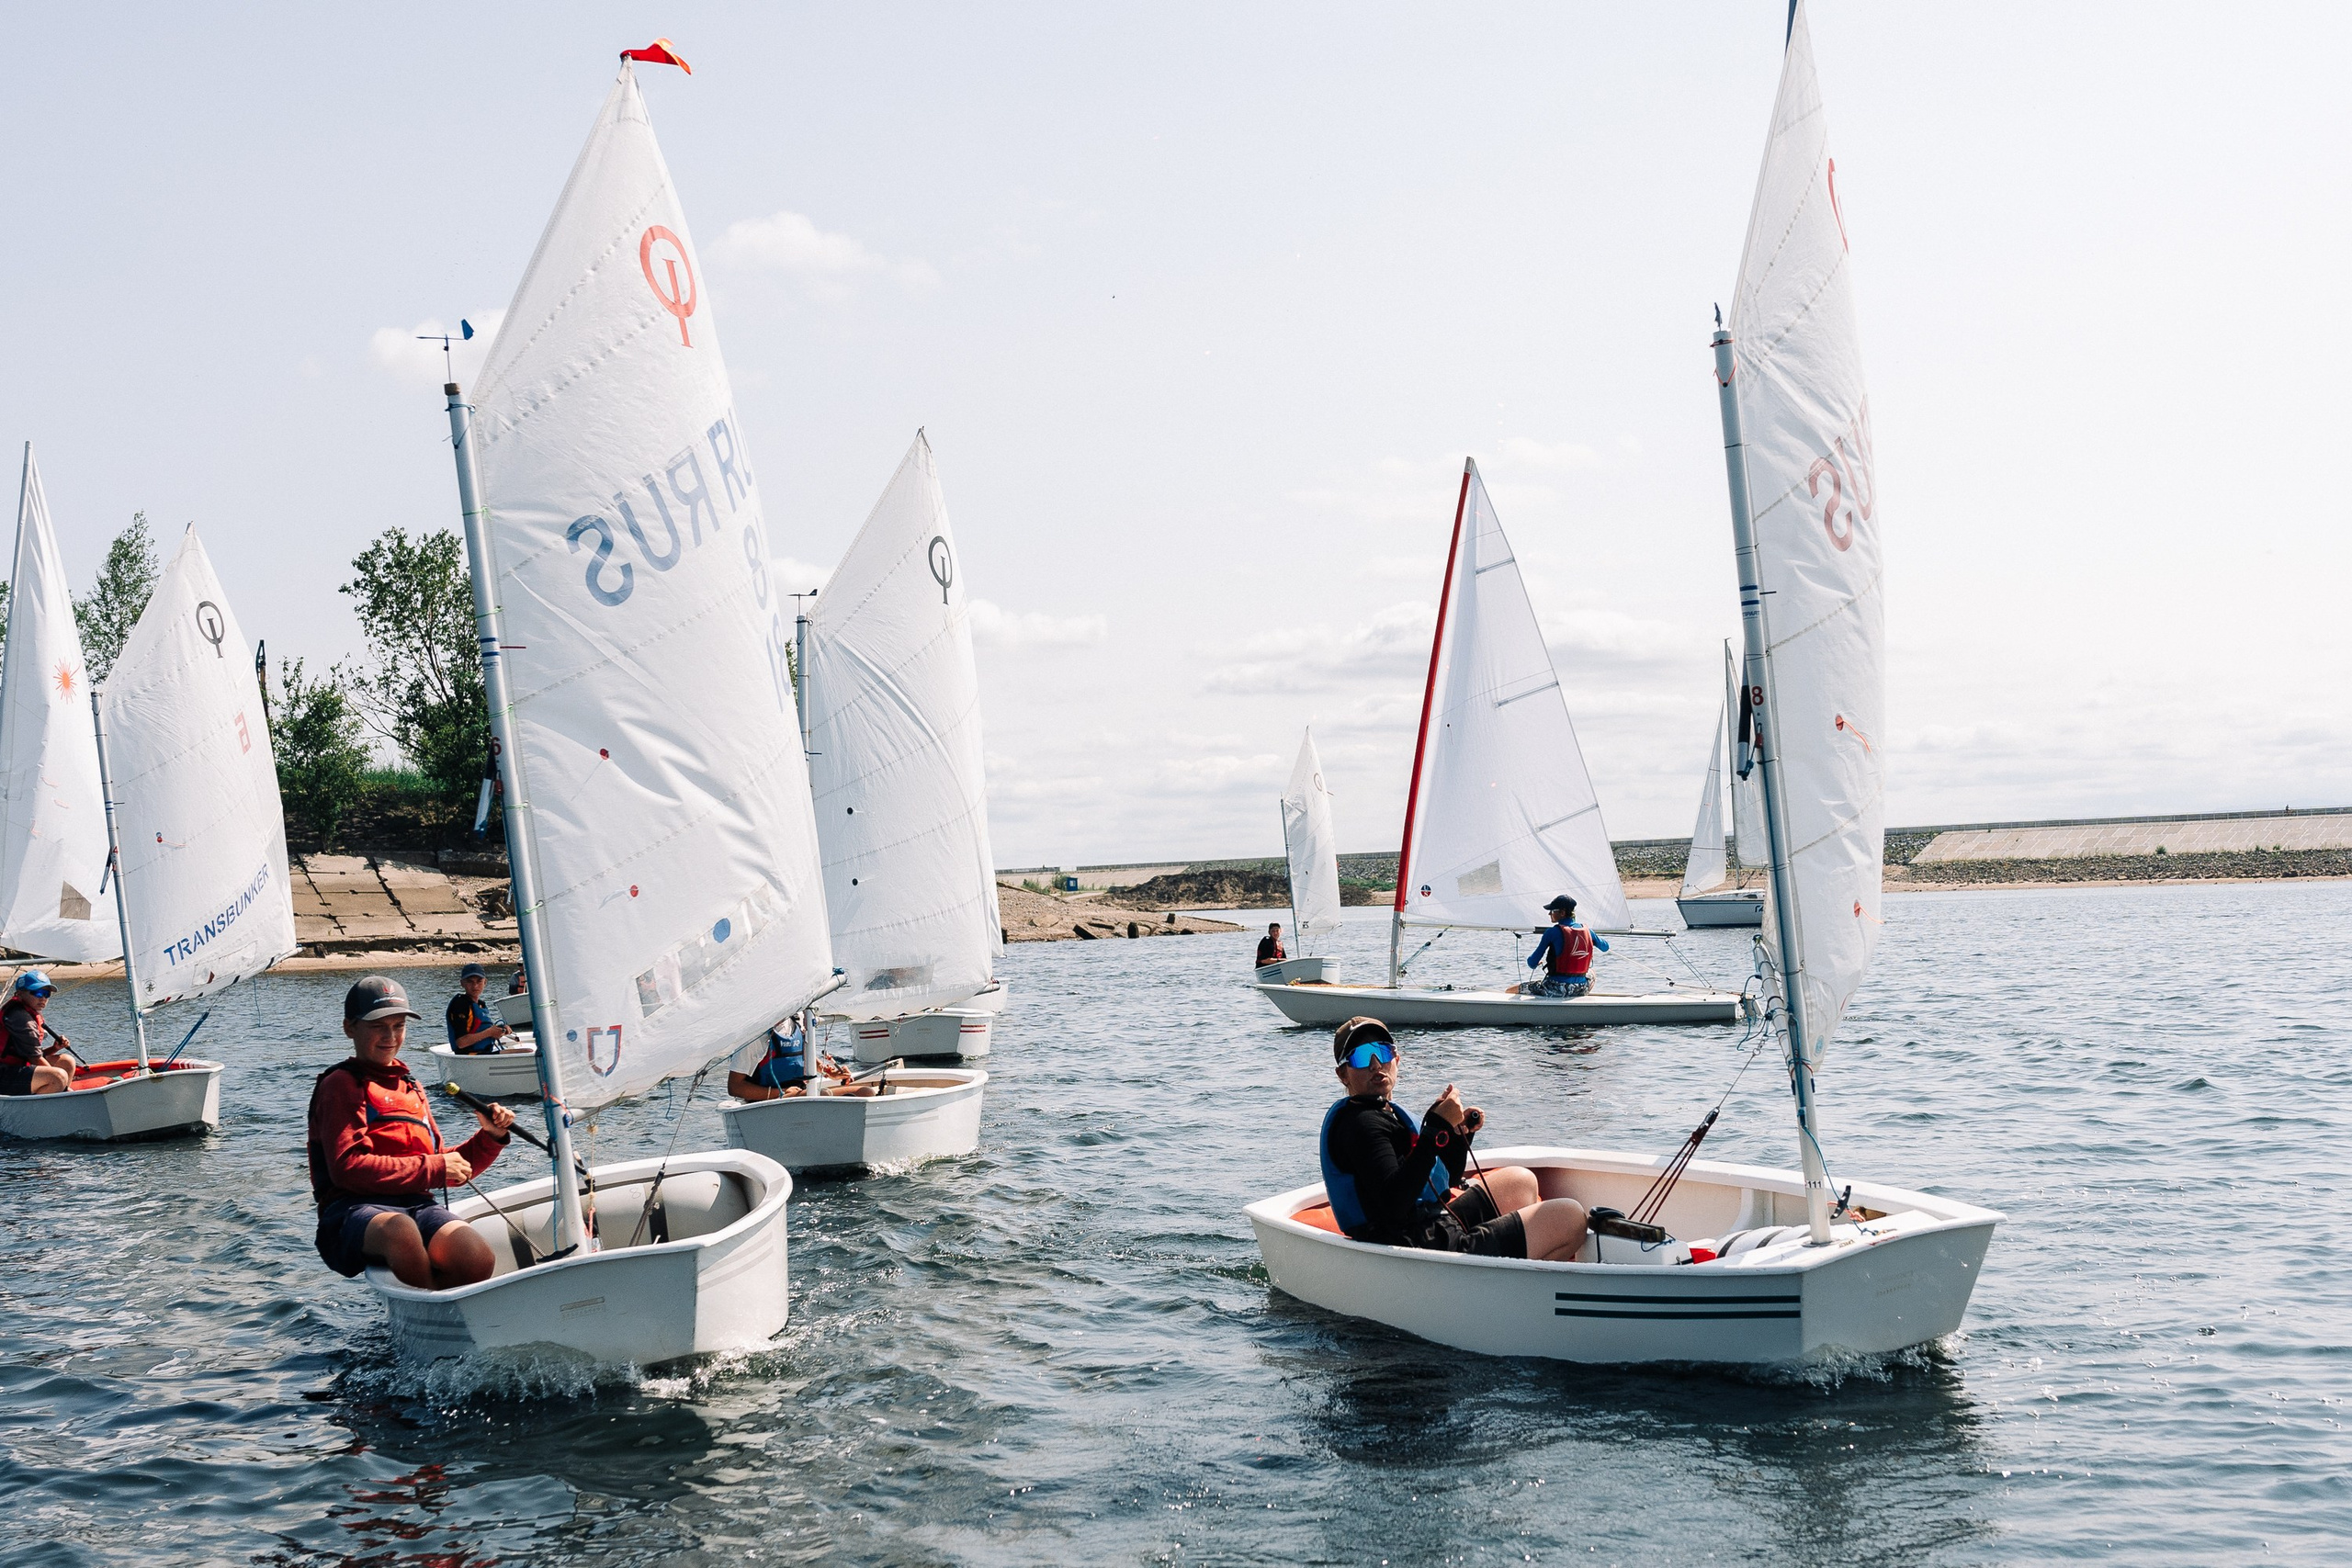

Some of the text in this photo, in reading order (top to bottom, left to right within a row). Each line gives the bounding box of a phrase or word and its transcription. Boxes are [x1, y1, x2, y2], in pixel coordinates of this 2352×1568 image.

[1751, 685, 1764, 706] 8
[492, 736, 503, 756] 6
[163, 863, 269, 967] TRANSBUNKER
